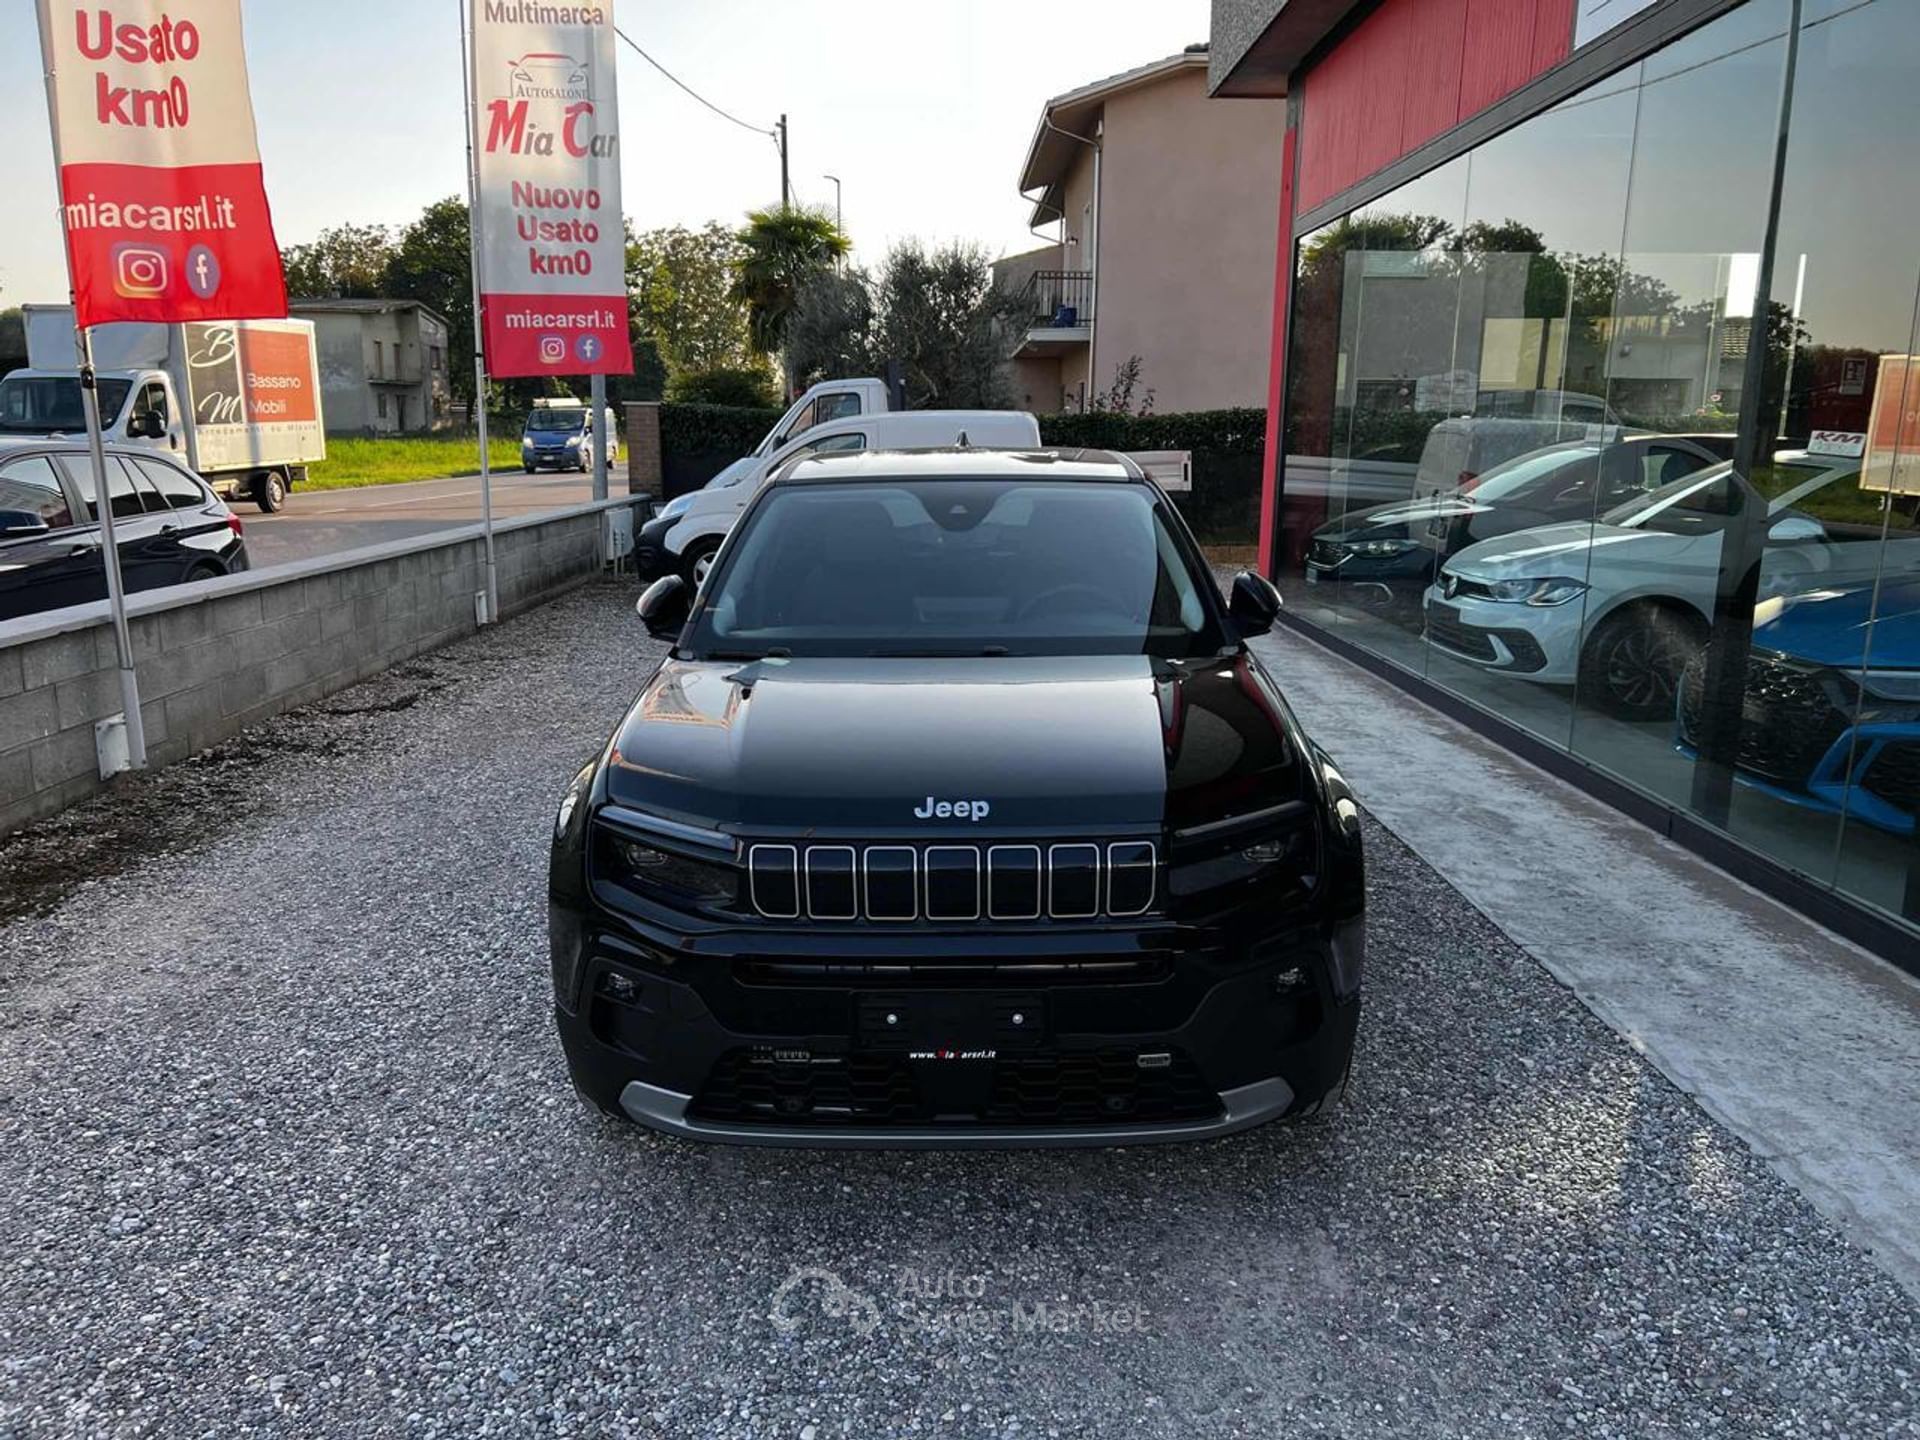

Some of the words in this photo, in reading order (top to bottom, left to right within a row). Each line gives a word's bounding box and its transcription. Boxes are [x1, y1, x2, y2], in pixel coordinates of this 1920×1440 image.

[484, 0, 604, 25] Multimarca
[75, 9, 200, 64] Usato
[95, 71, 189, 128] km0
[485, 99, 554, 157] Mia
[562, 101, 617, 158] Car
[511, 180, 602, 210] Nuovo
[66, 193, 237, 232] miacarsrl.it
[517, 214, 599, 244] Usato
[529, 247, 593, 276] km0
[505, 309, 616, 328] miacarsrl.it
[247, 372, 302, 389] Bassano
[249, 398, 287, 414] Mobili
[913, 796, 990, 821] Jeep
